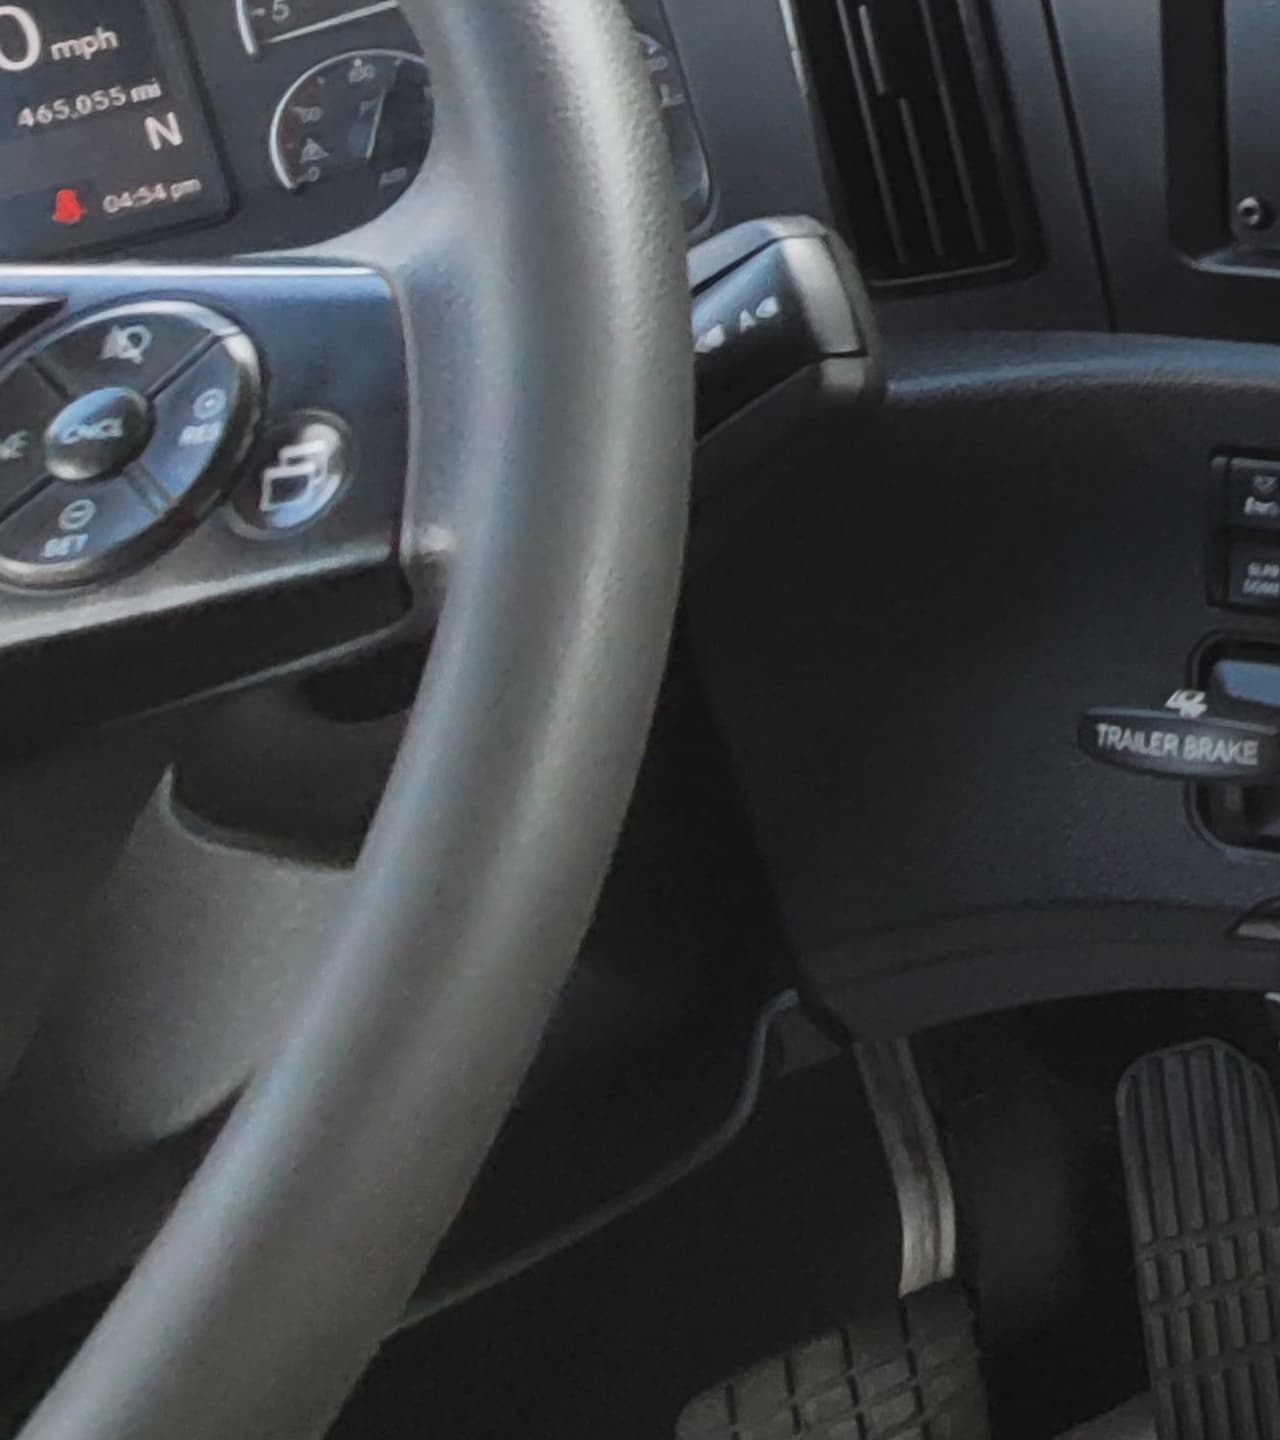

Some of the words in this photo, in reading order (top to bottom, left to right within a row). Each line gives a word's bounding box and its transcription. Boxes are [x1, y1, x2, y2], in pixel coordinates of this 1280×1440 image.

[50, 26, 120, 61] mph
[143, 111, 184, 151] N
[1095, 722, 1179, 759] TRAILER
[1183, 734, 1260, 766] BRAKE
